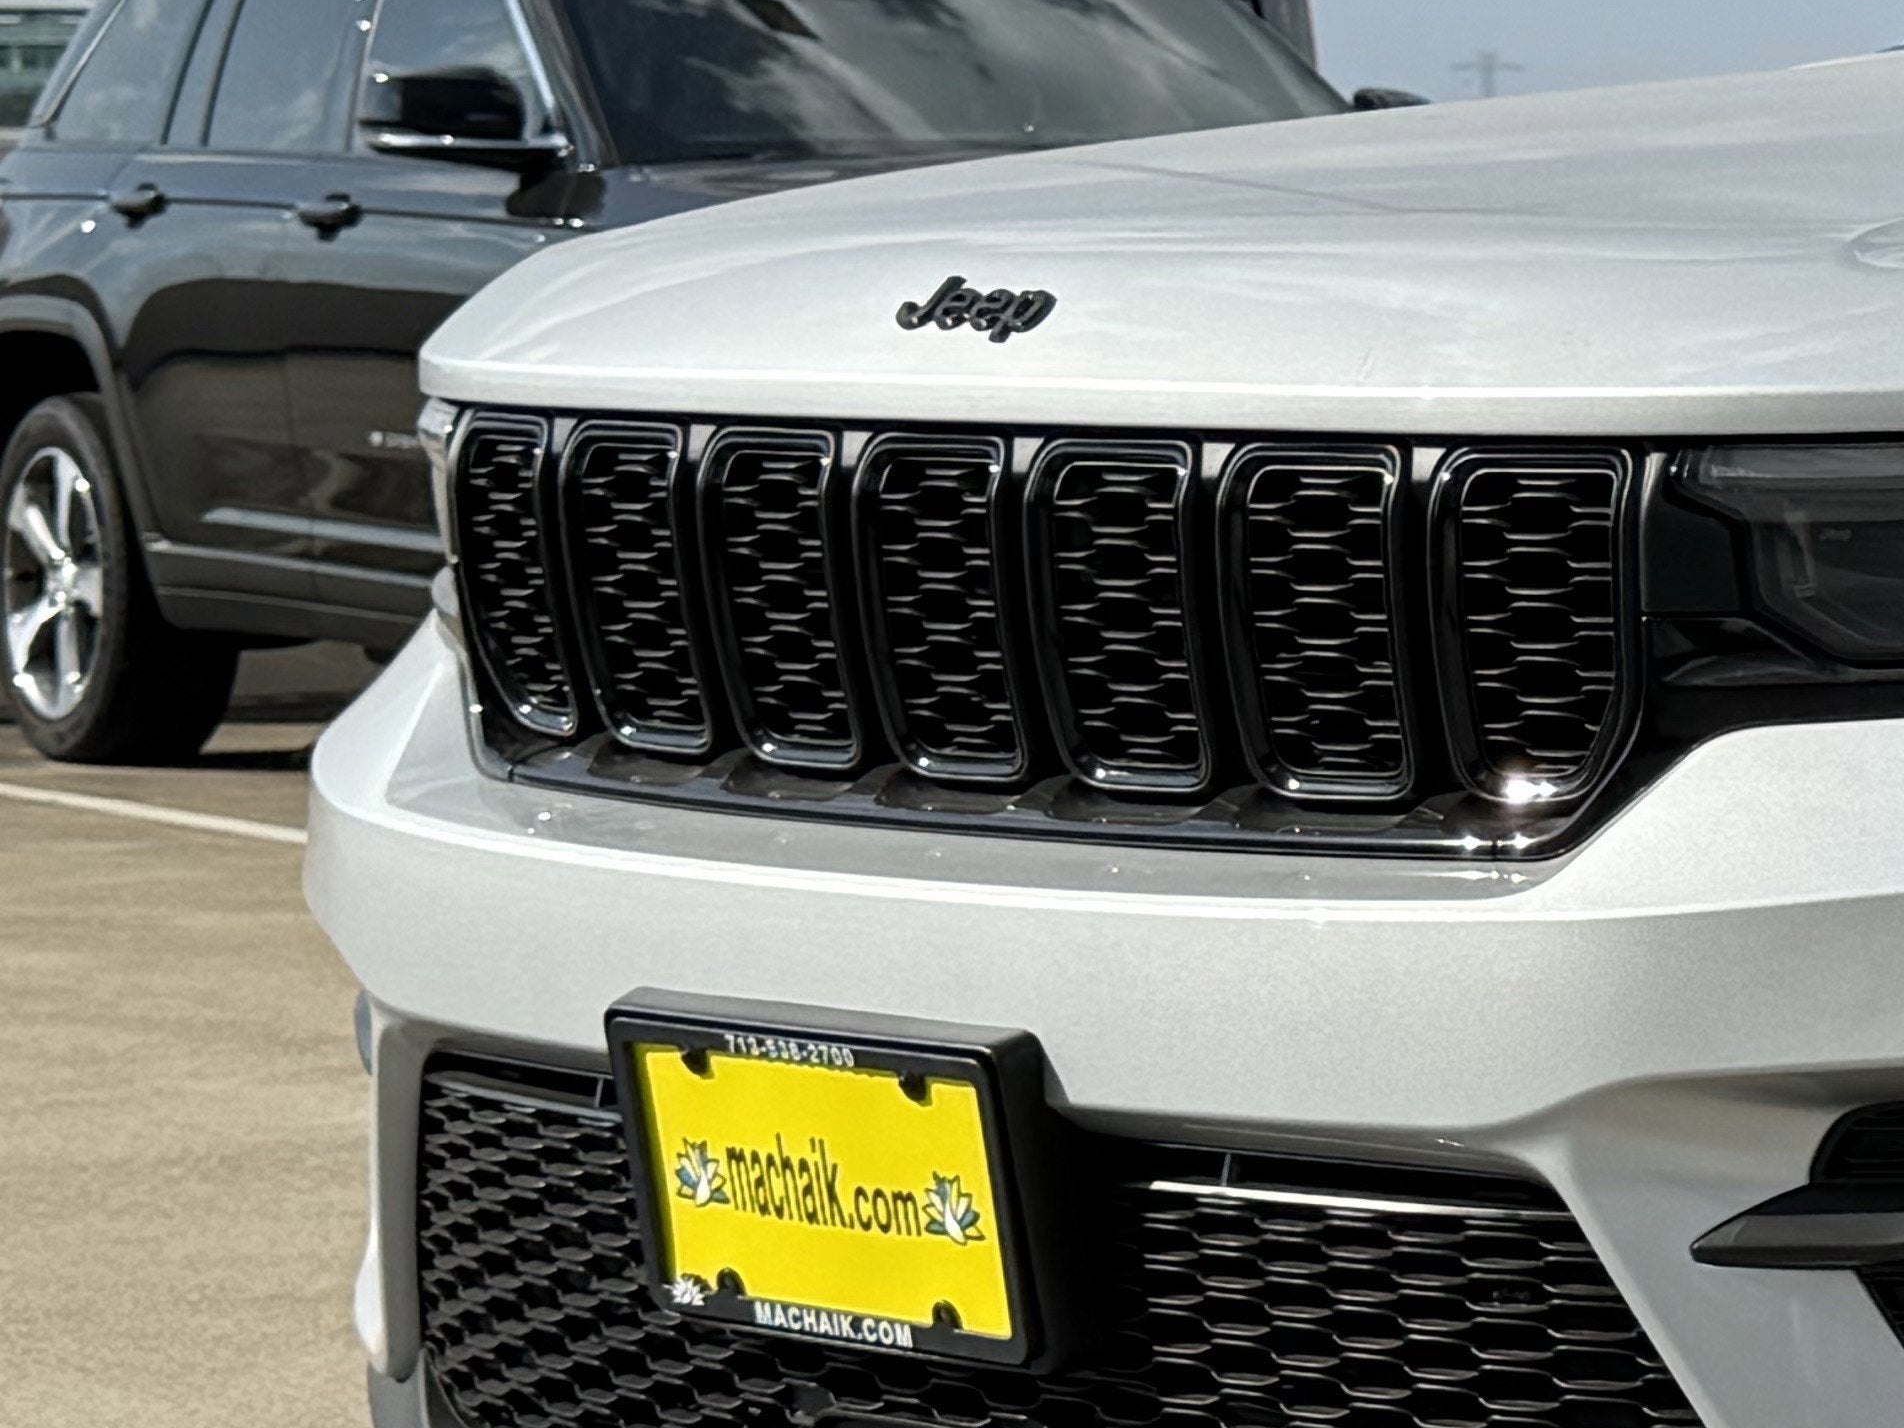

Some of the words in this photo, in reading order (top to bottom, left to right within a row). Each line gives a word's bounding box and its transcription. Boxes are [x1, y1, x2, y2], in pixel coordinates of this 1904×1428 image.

[895, 274, 1058, 344] Jeep
[725, 1132, 923, 1237] machaik.com
[753, 1301, 914, 1349] MACHAIK.COM
